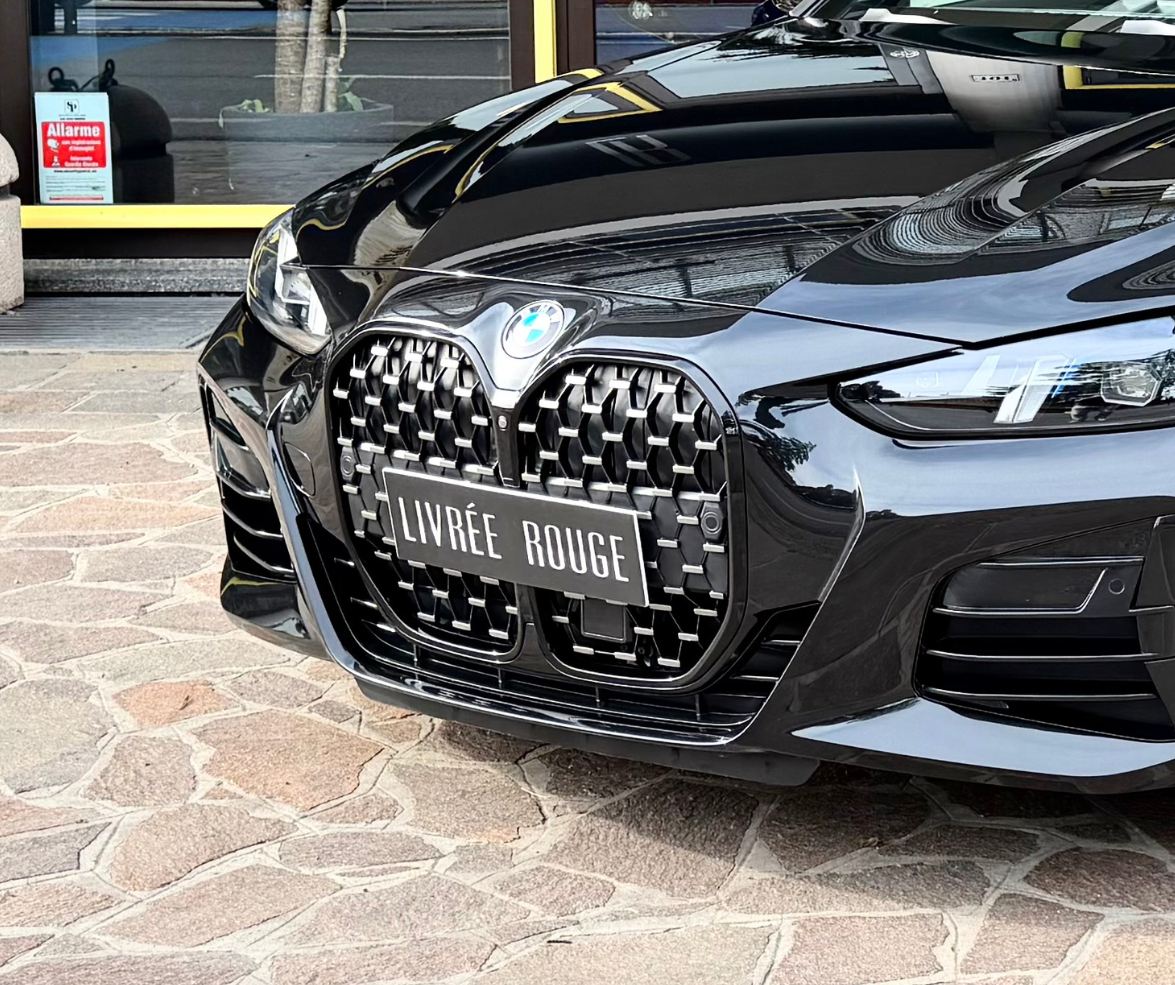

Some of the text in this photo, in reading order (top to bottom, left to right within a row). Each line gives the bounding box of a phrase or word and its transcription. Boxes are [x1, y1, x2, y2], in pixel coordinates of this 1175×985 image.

[47, 123, 100, 137] Allarme
[397, 497, 630, 583] LIVRÉE ROUGE
